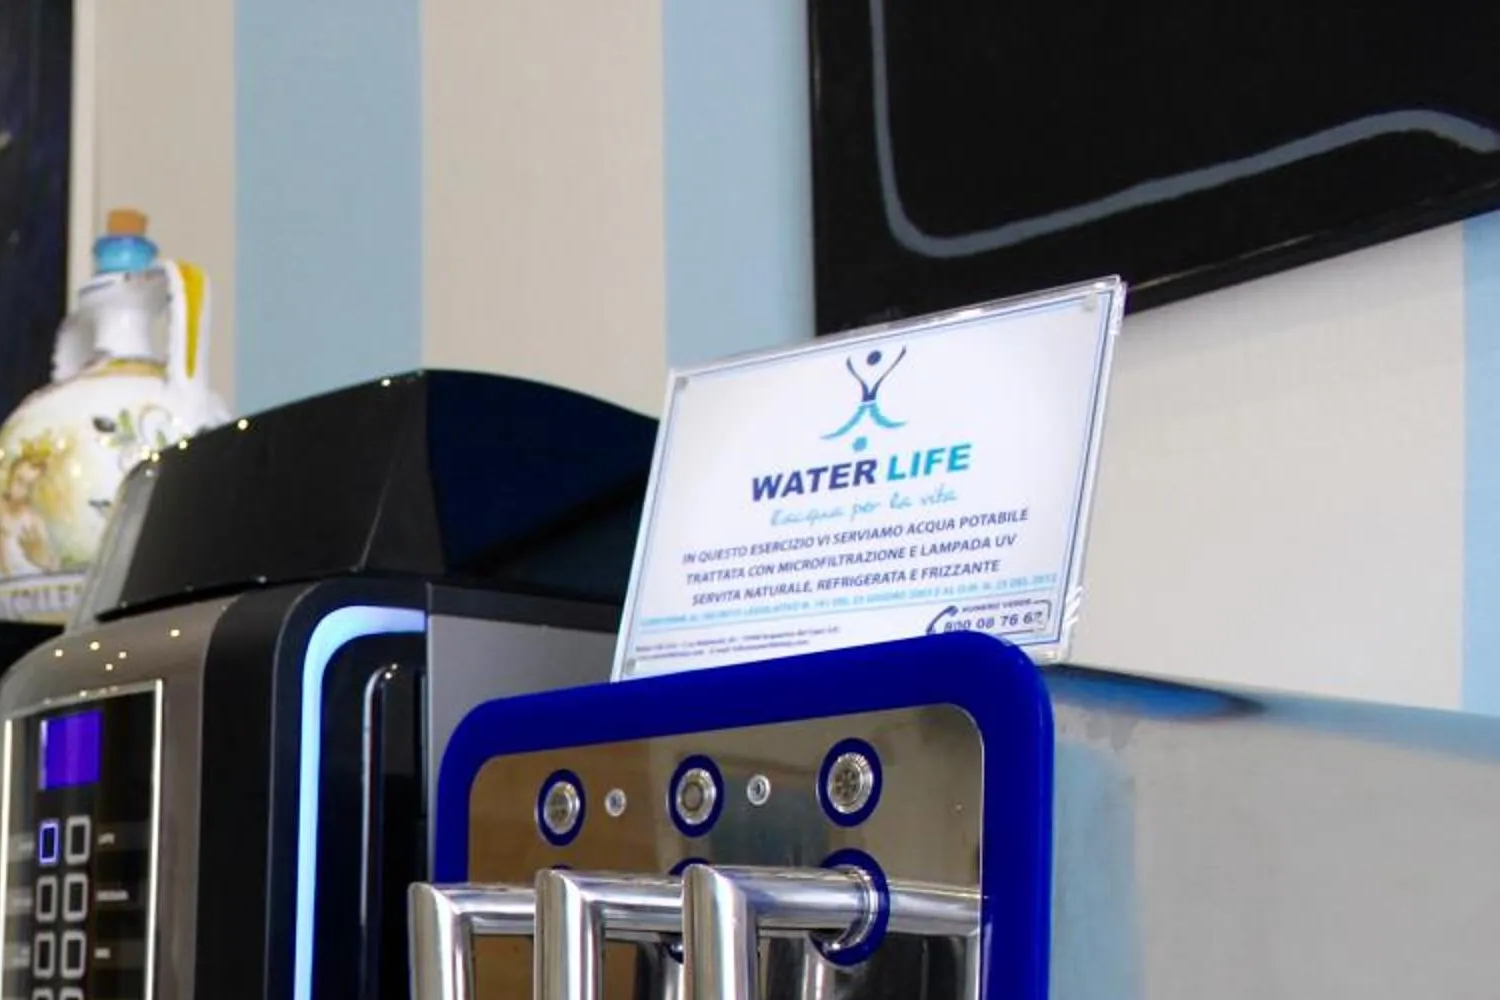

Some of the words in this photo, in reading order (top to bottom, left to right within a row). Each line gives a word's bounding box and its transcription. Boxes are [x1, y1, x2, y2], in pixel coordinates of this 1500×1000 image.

[751, 459, 877, 502] WATER
[887, 443, 972, 481] LIFE
[851, 501, 880, 520] per
[889, 490, 912, 509] la
[921, 483, 957, 505] vita
[682, 553, 696, 565] IN
[698, 546, 749, 563] QUESTO
[750, 536, 815, 557] ESERCIZIO
[817, 534, 831, 547] VI
[834, 525, 903, 545] SERVIAMO
[907, 518, 956, 535] ACQUA
[959, 507, 1029, 529] POTABILE
[687, 568, 745, 585] TRATTATA
[748, 564, 775, 578] CON
[777, 547, 905, 574] MICROFILTRAZIONE
[909, 546, 918, 558] E
[921, 536, 991, 557] LAMPADA
[995, 533, 1018, 548] UV
[692, 590, 741, 607] SERVITA
[817, 569, 906, 591] REFRIGERATA
[910, 569, 918, 581] E
[921, 559, 1001, 579] FRIZZANTE
